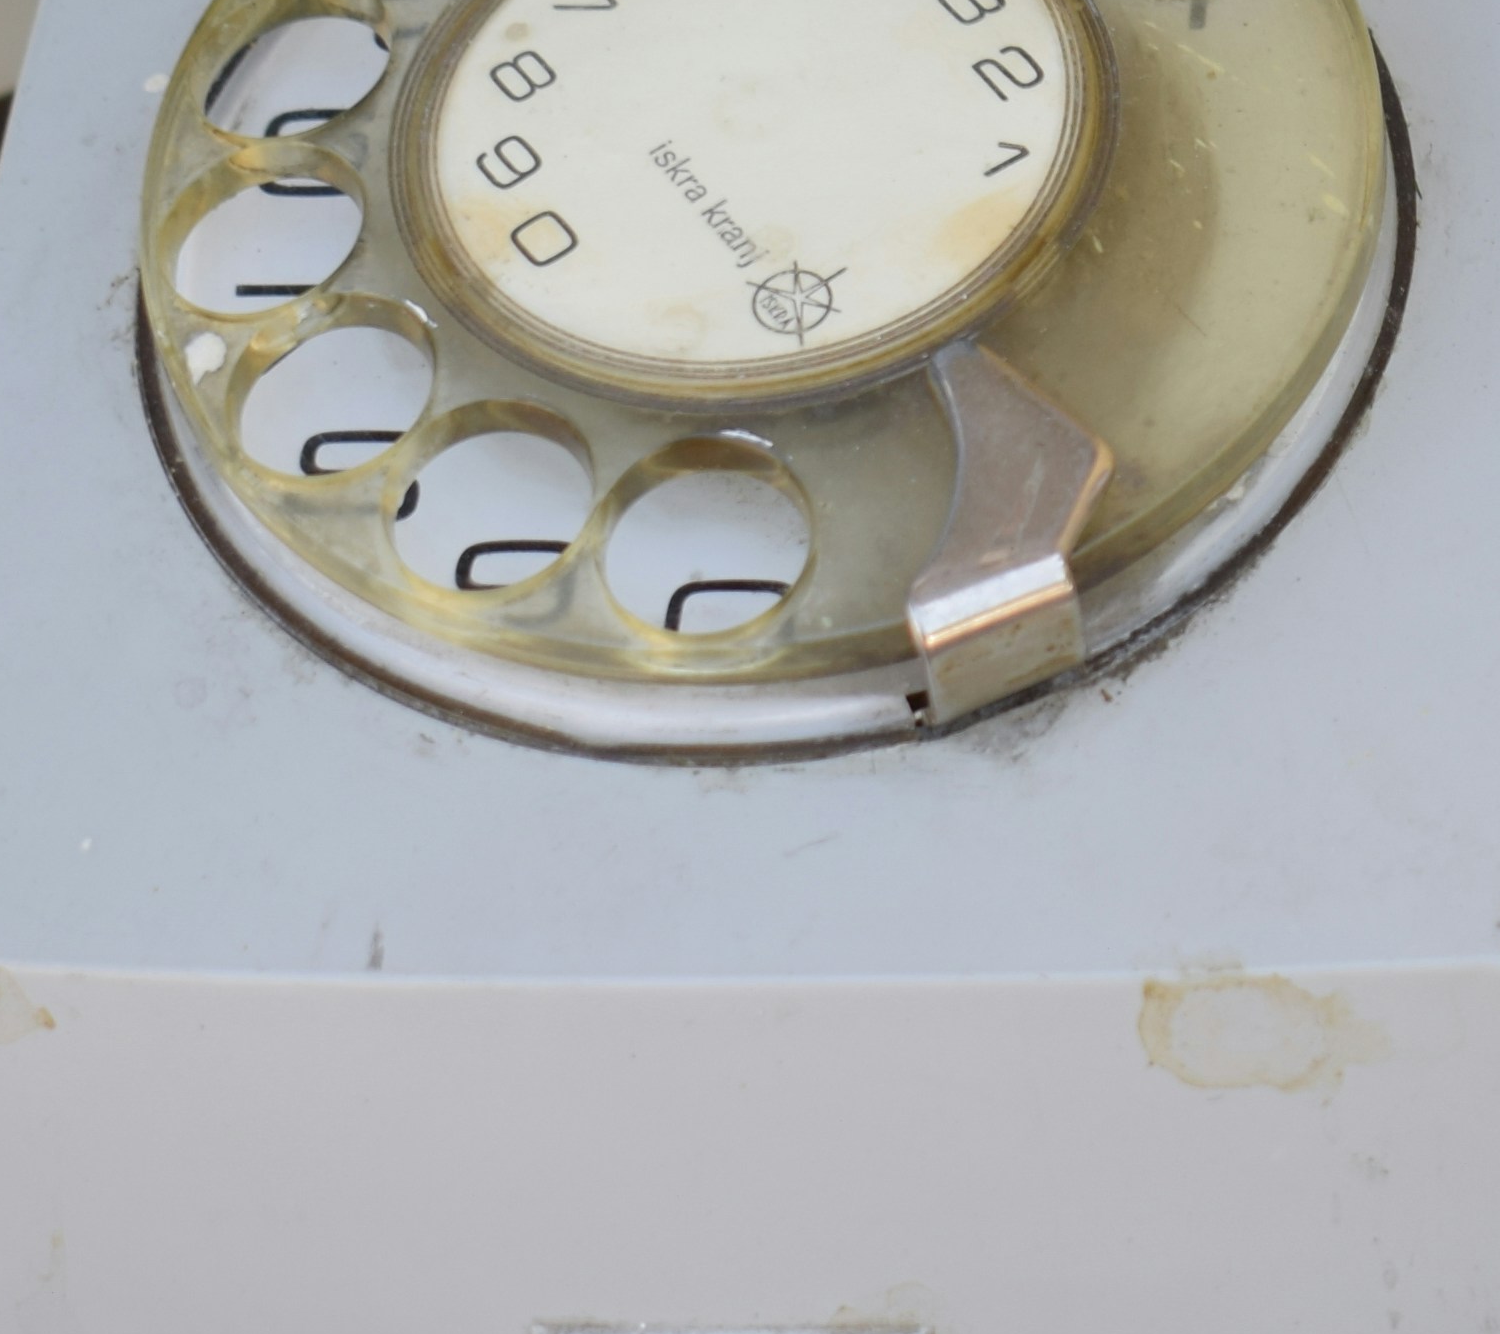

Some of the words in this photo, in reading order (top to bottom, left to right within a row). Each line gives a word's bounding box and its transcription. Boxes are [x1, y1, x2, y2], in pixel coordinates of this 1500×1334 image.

[488, 50, 557, 103] 8
[971, 45, 1045, 102] 2
[475, 135, 543, 190] 9
[984, 142, 1030, 178] 1
[649, 139, 708, 204] iskra
[701, 198, 770, 269] kranj
[509, 210, 579, 268] 0
